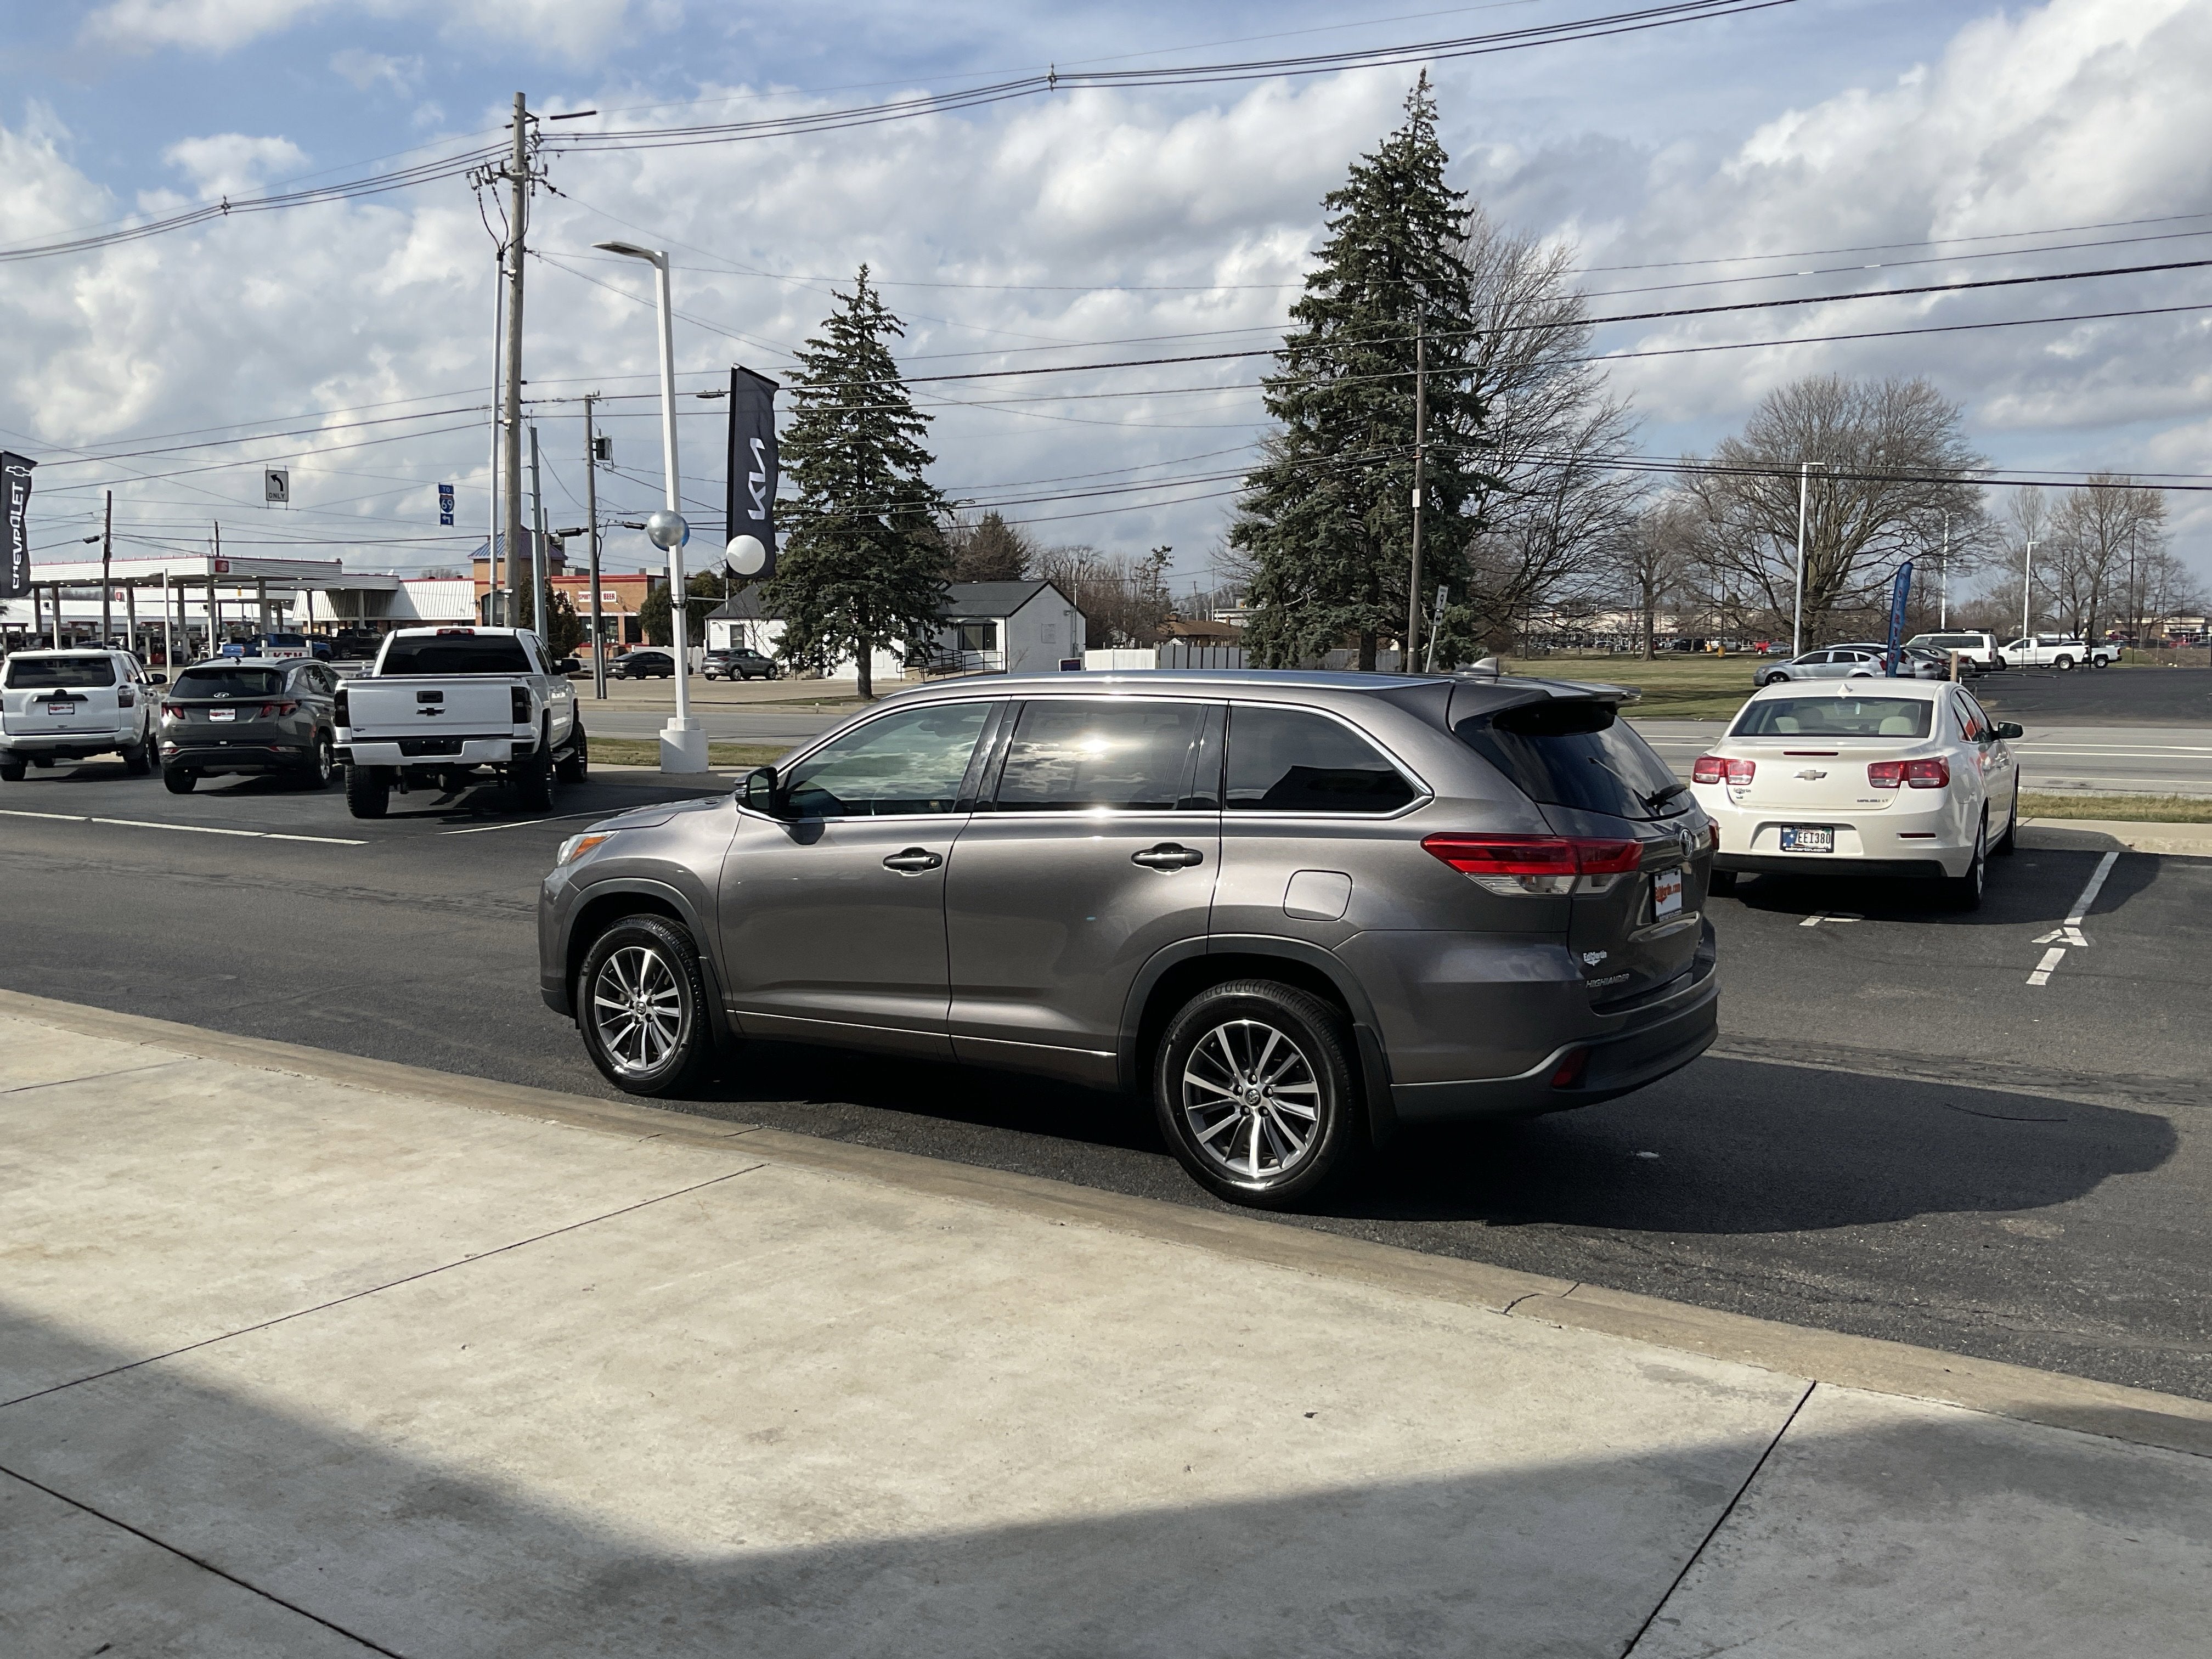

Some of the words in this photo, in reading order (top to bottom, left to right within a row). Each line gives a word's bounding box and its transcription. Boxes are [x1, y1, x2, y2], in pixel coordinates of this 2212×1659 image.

[747, 437, 766, 520] KIA
[442, 499, 453, 510] 69
[1440, 594, 1444, 606] 9
[1798, 832, 1831, 844] EEI380
[1585, 973, 1629, 988] HIGHLANDER
